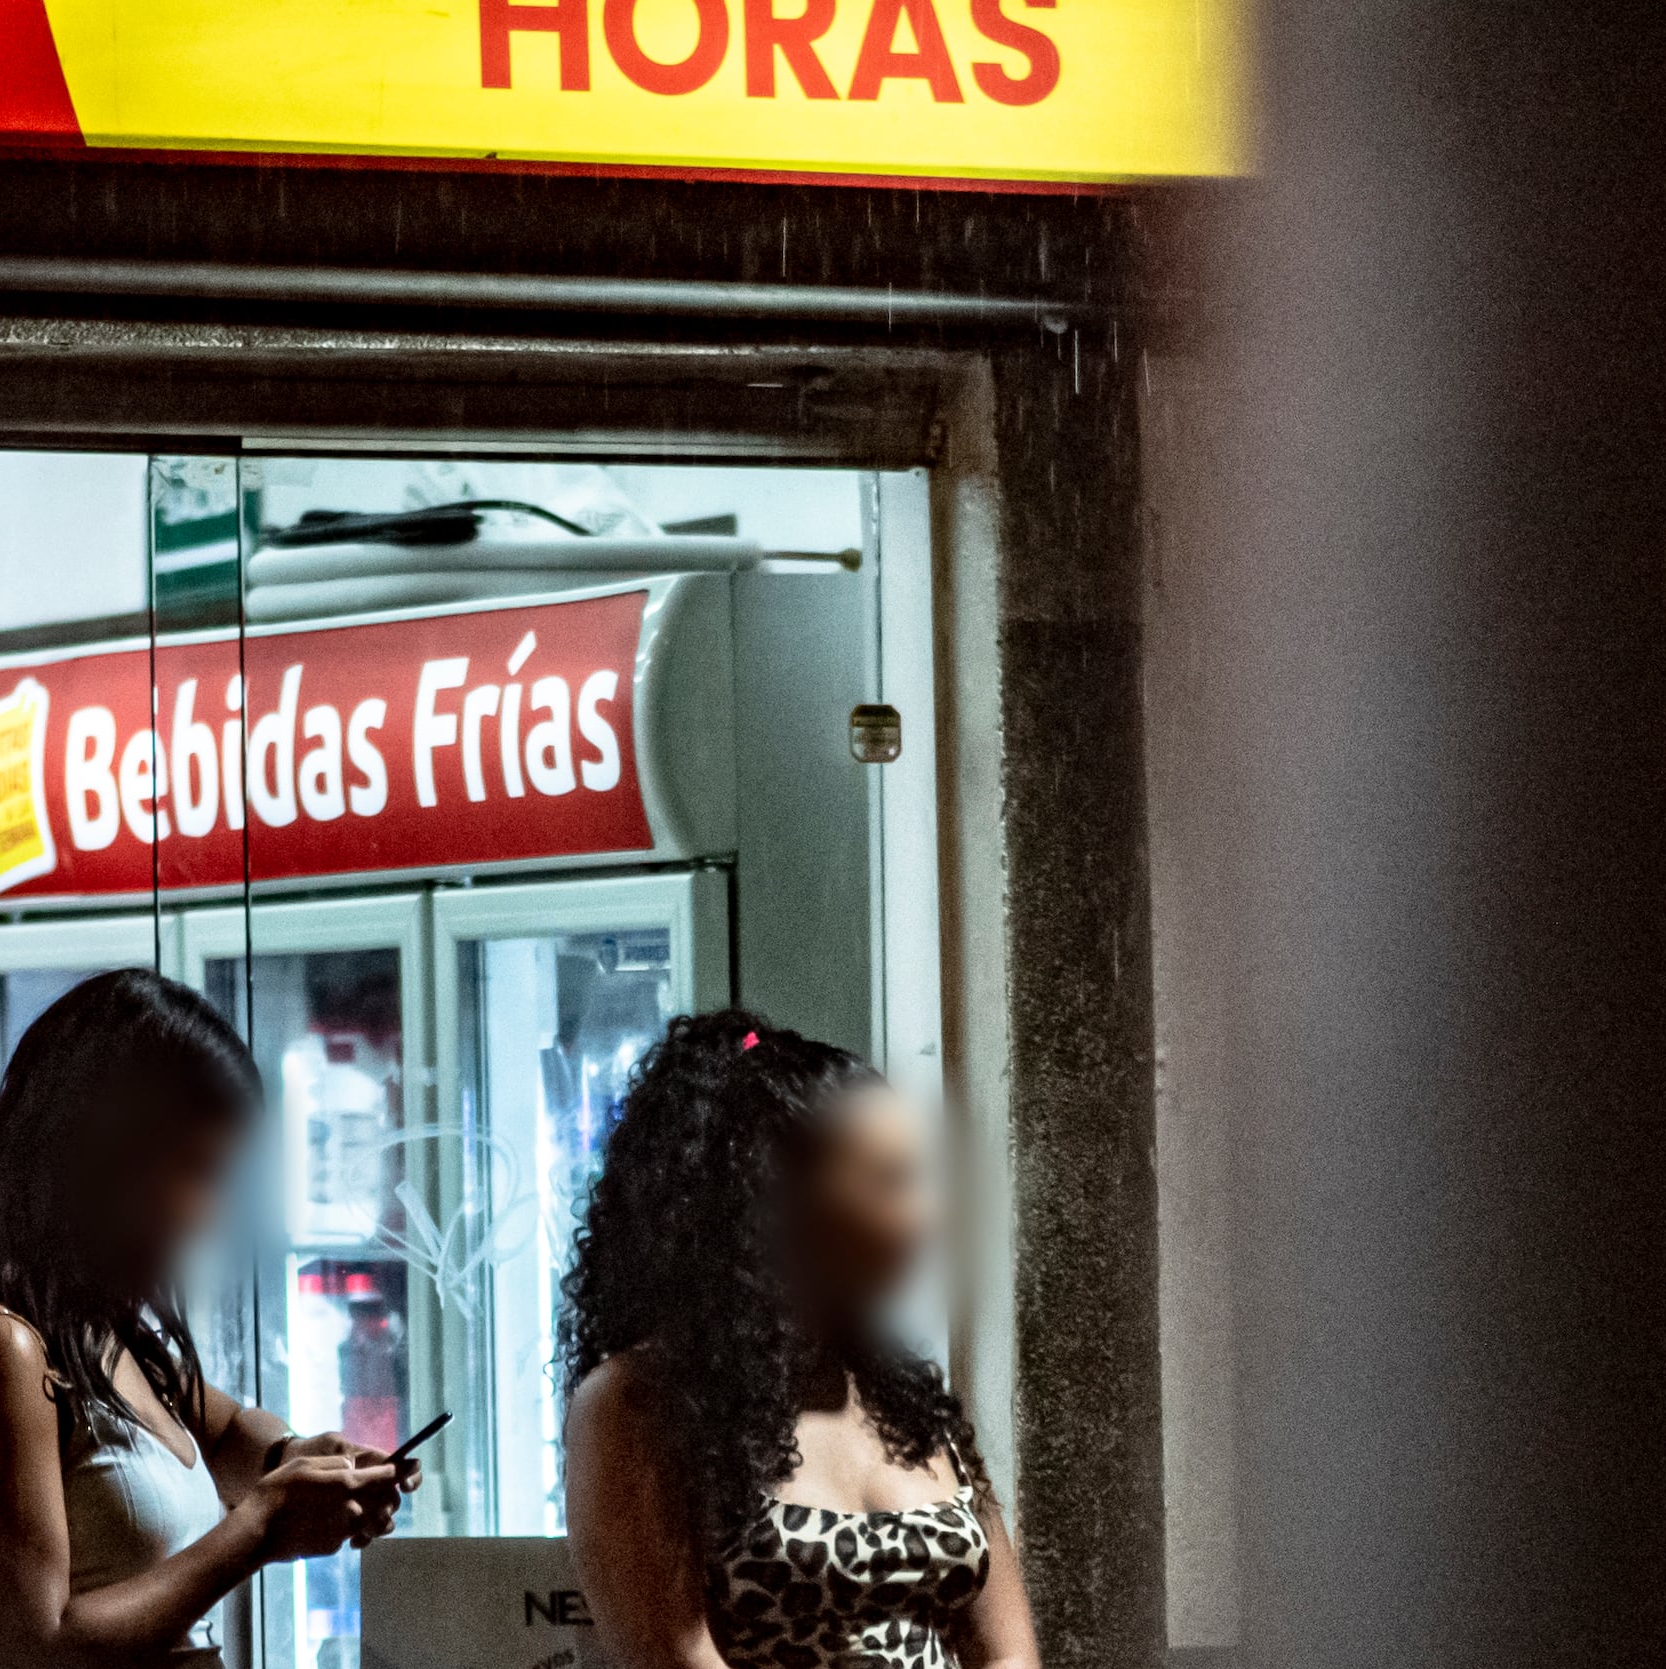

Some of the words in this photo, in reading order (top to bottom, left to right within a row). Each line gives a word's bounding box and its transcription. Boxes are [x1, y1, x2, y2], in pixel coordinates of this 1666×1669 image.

[479, 0, 1061, 106] HORAS
[64, 664, 388, 851] Bebidas
[413, 631, 621, 807] Frías
[524, 1589, 594, 1627] NE
